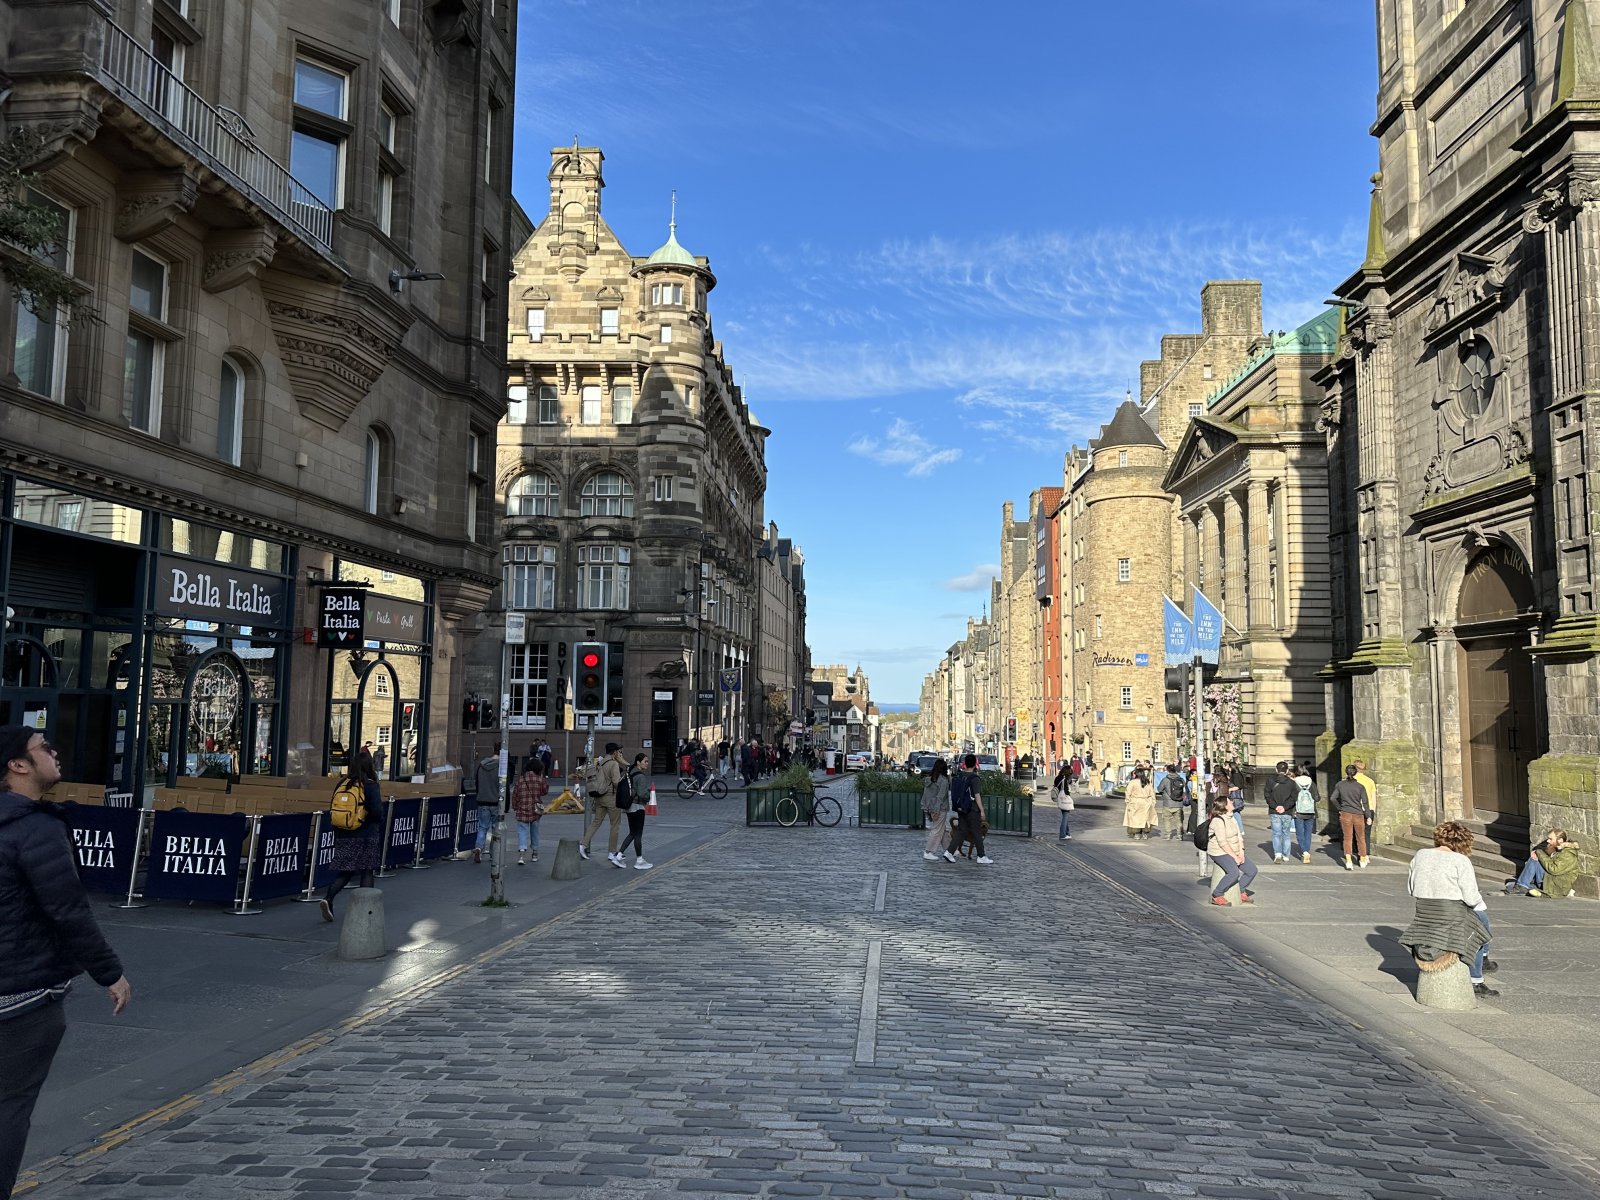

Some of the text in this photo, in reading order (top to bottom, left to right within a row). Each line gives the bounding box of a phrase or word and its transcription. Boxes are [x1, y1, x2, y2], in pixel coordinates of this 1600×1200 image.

[1470, 550, 1498, 583] TRON
[169, 568, 272, 615] Bella Italia
[324, 596, 361, 611] Bella
[323, 614, 360, 629] Italia
[376, 610, 414, 630] Pasta Grill
[1092, 651, 1133, 668] Radisson
[201, 678, 231, 696] Bella
[555, 642, 566, 730] BYRON
[393, 817, 414, 832] BELLA
[432, 813, 450, 827] BELLA
[465, 809, 478, 822] BELL
[73, 828, 115, 849] ELLA
[391, 831, 414, 847] ITALIA
[430, 826, 450, 841] ITALIA
[165, 835, 227, 856] BELLA
[265, 836, 299, 856] BELLA
[162, 855, 227, 876] ITALIA
[262, 855, 298, 875] ITALIA
